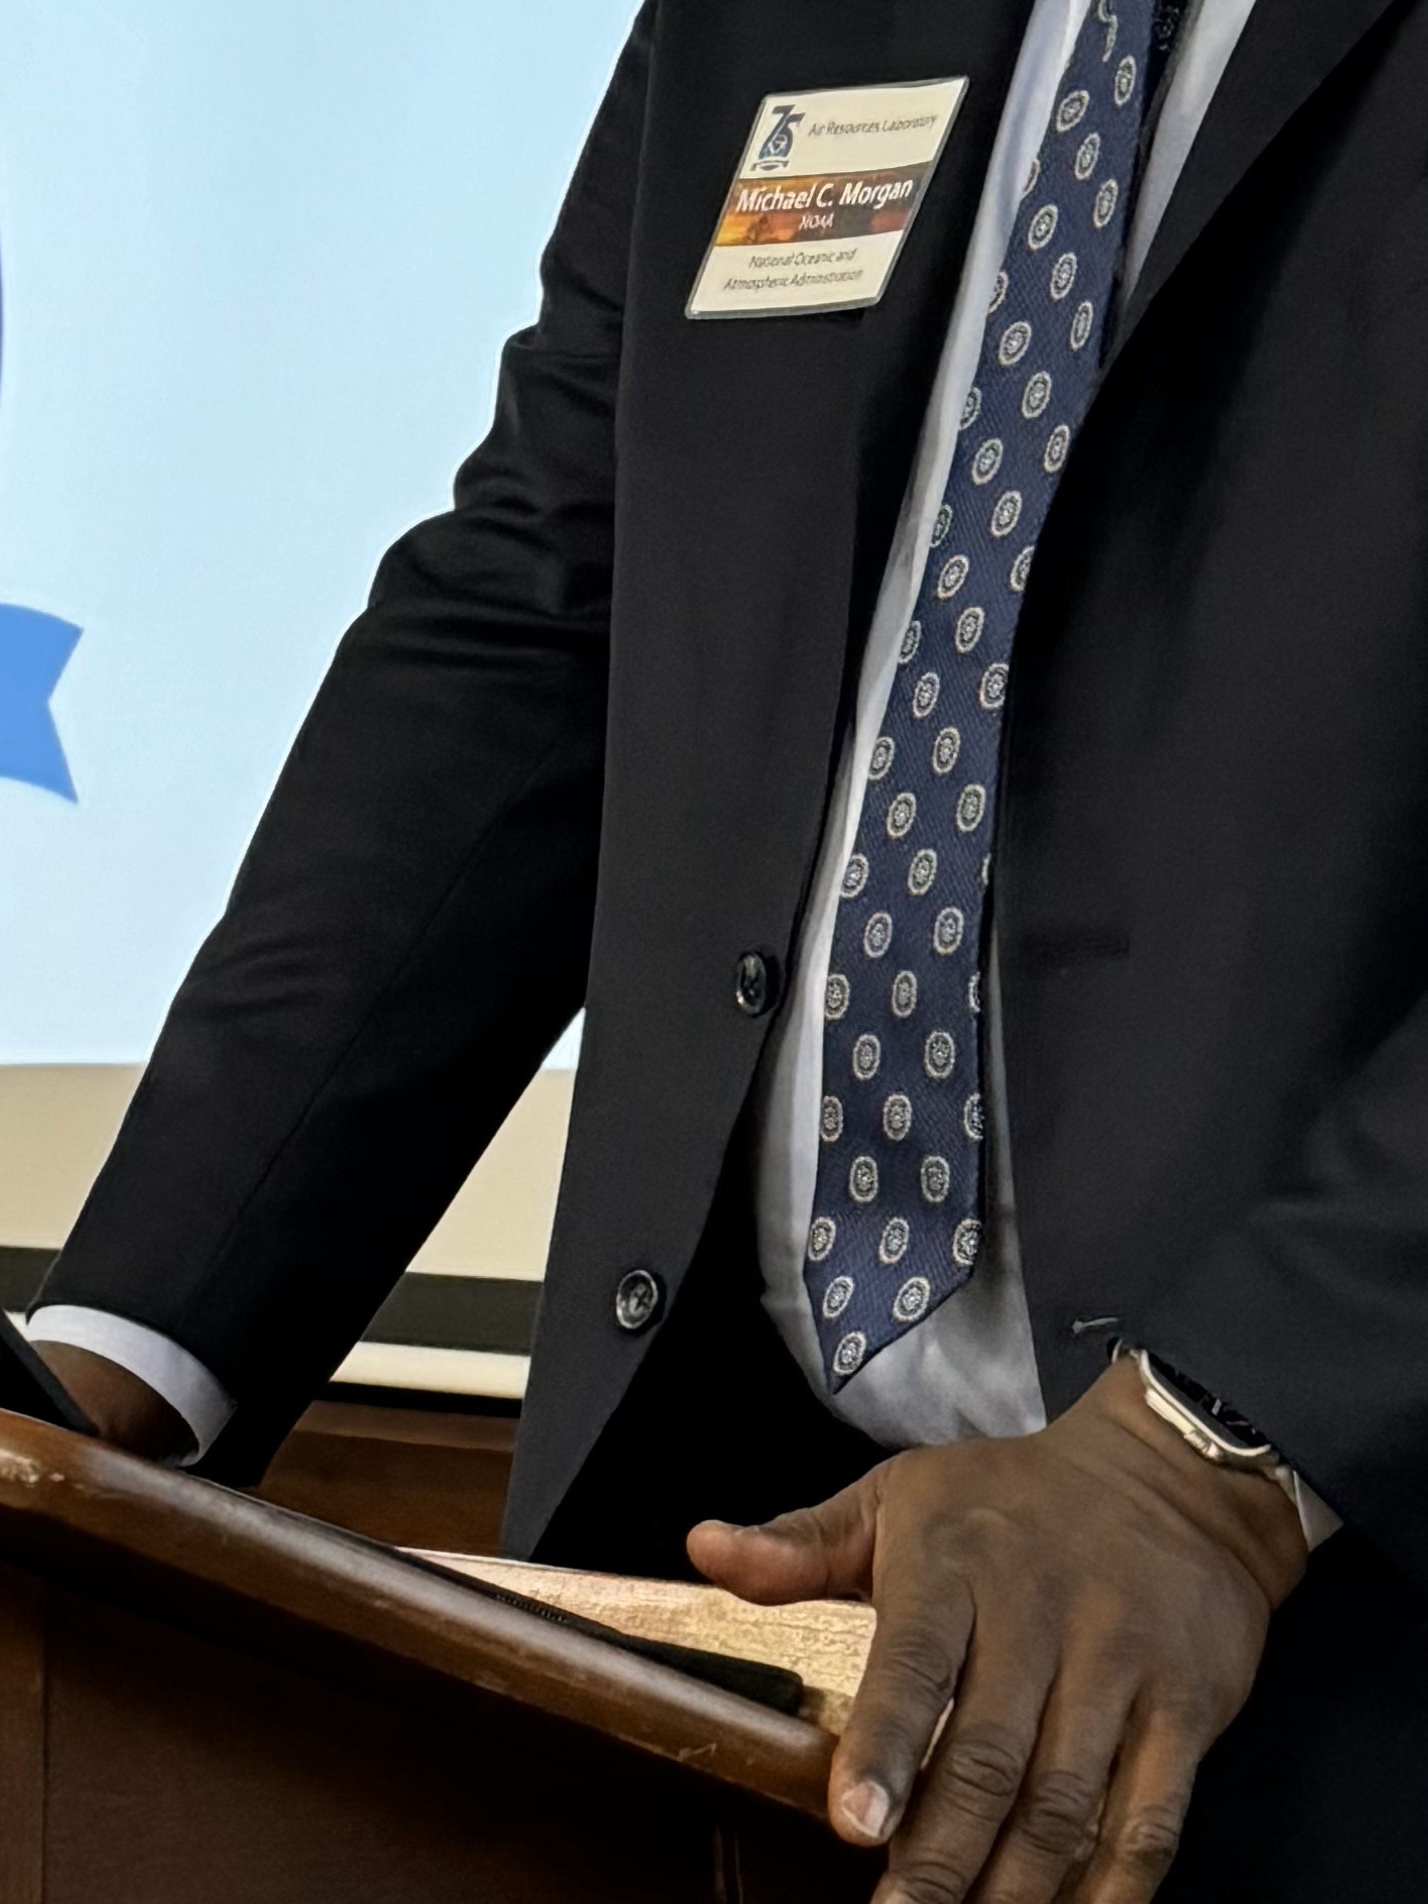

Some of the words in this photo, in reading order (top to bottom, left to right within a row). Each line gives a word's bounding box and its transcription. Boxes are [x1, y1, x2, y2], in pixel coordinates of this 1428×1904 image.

[808, 122, 826, 137] Air
[735, 183, 814, 213] Michael
[816, 182, 834, 208] C.
[838, 179, 914, 210] Morgan
[798, 213, 834, 230] NOAA
[834, 248, 858, 262] and
